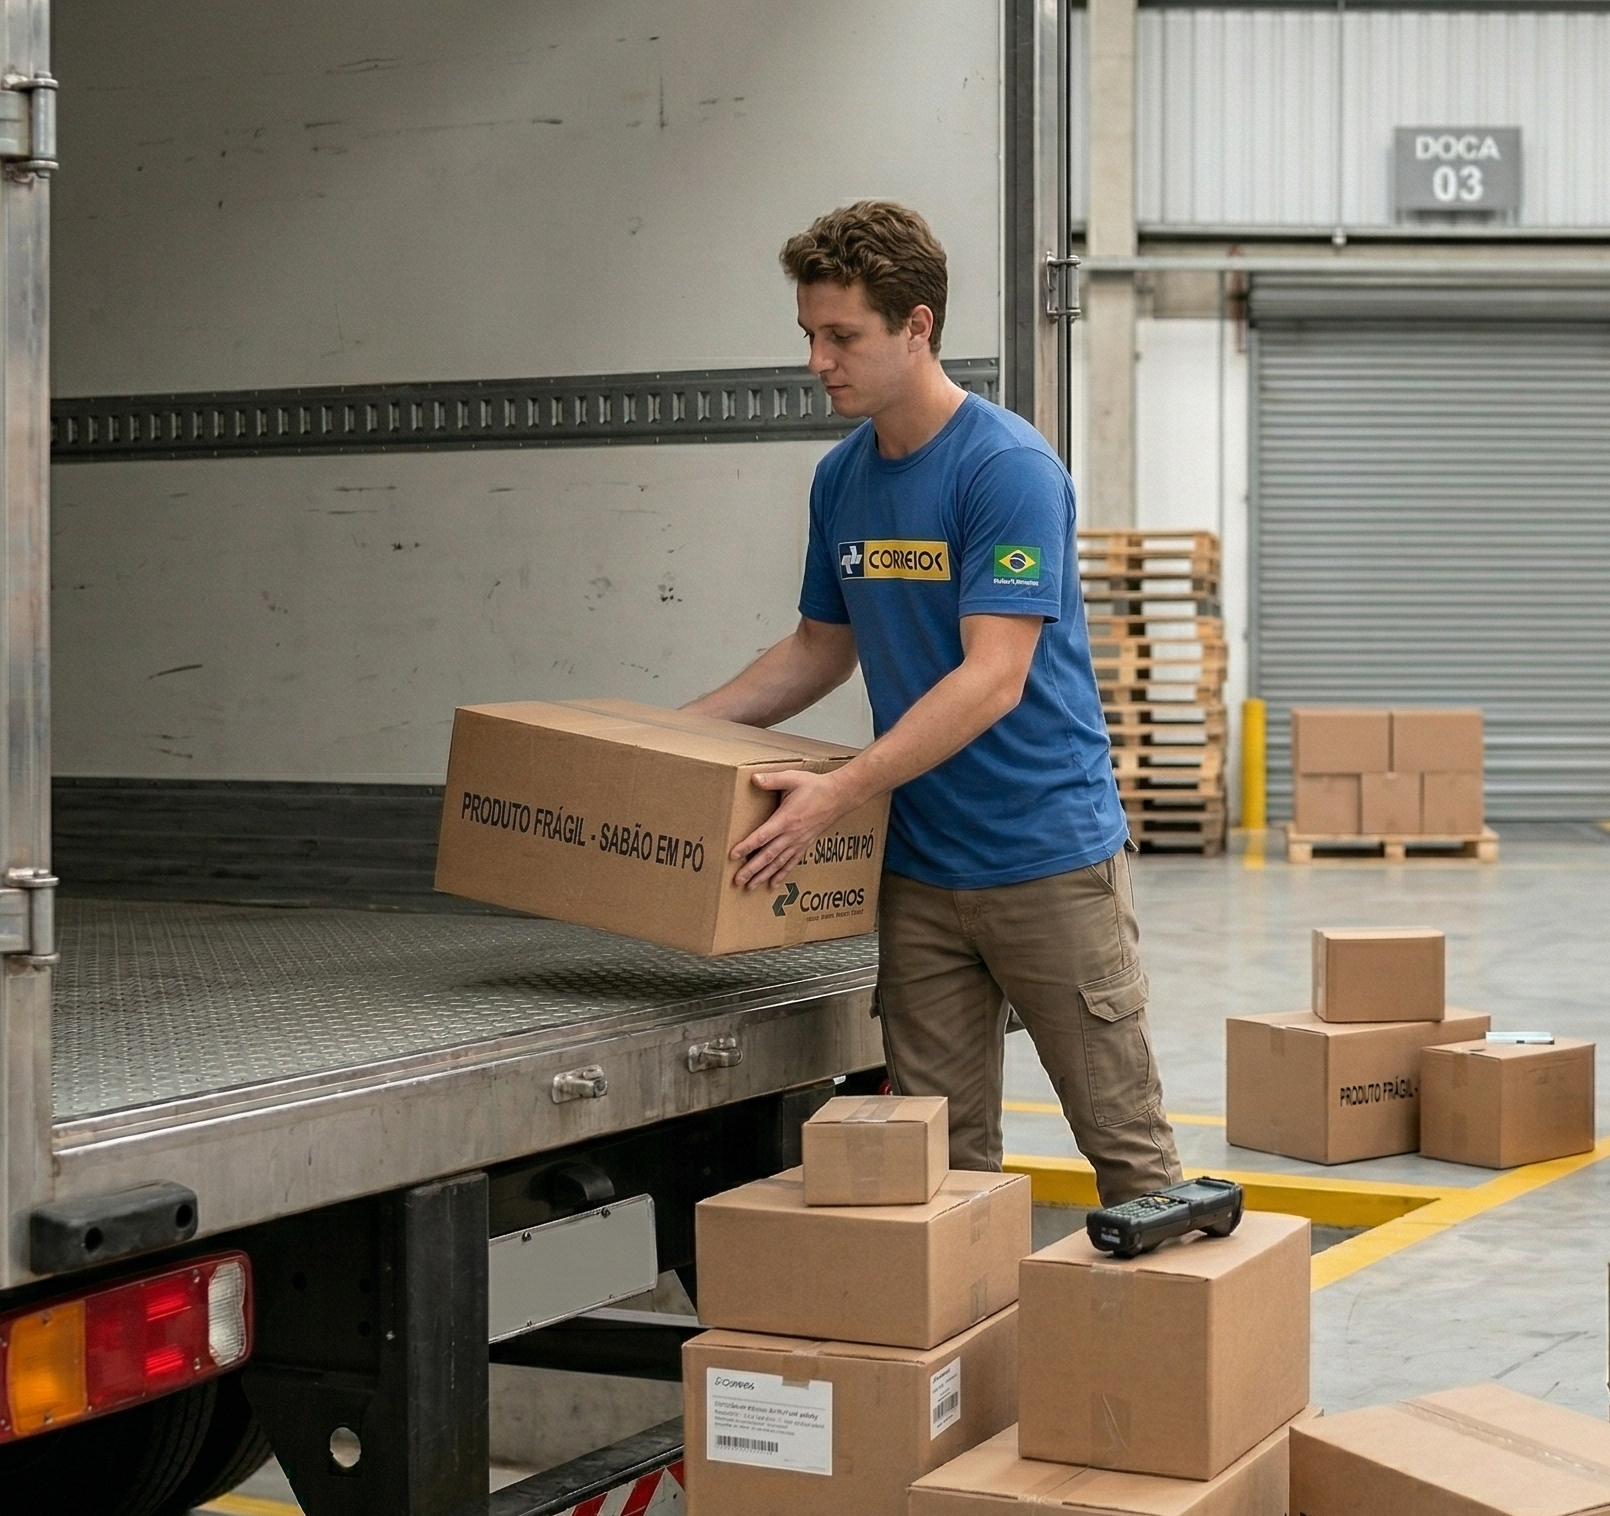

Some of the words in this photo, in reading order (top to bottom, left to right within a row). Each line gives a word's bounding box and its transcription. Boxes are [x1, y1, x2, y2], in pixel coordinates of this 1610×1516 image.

[1415, 134, 1502, 161] DOCA
[1432, 164, 1484, 202] 03
[461, 791, 531, 833] PRODUTO
[533, 805, 586, 847] FRÁGIL
[599, 822, 653, 861] SABÃO
[655, 834, 680, 867] EM
[681, 836, 705, 873] PÓ
[860, 827, 874, 859] PÓ
[799, 887, 865, 913] Correios
[1340, 1083, 1381, 1107] PRODUTO
